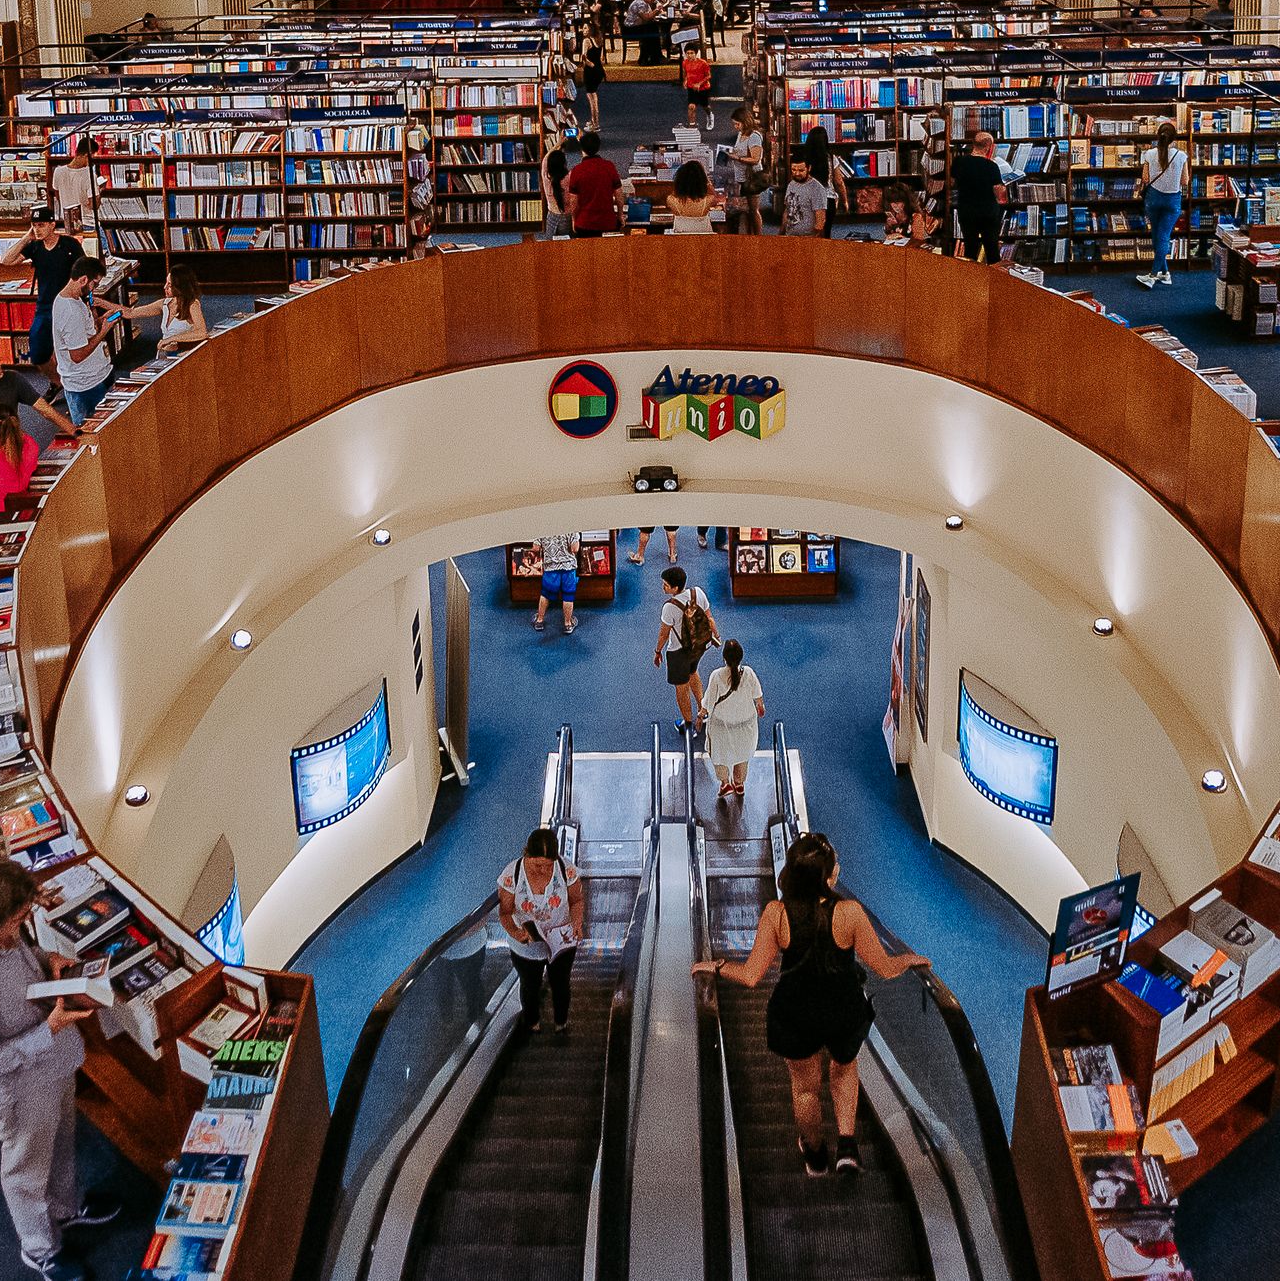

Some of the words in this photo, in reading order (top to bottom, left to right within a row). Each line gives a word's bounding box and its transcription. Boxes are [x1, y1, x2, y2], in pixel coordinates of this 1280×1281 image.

[1106, 89, 1140, 97] TURISMO
[207, 111, 254, 119] SOCIOLOGIA
[324, 109, 371, 117] SOCIOLOGIA
[649, 365, 780, 395] Ateneo
[644, 400, 783, 434] Junior
